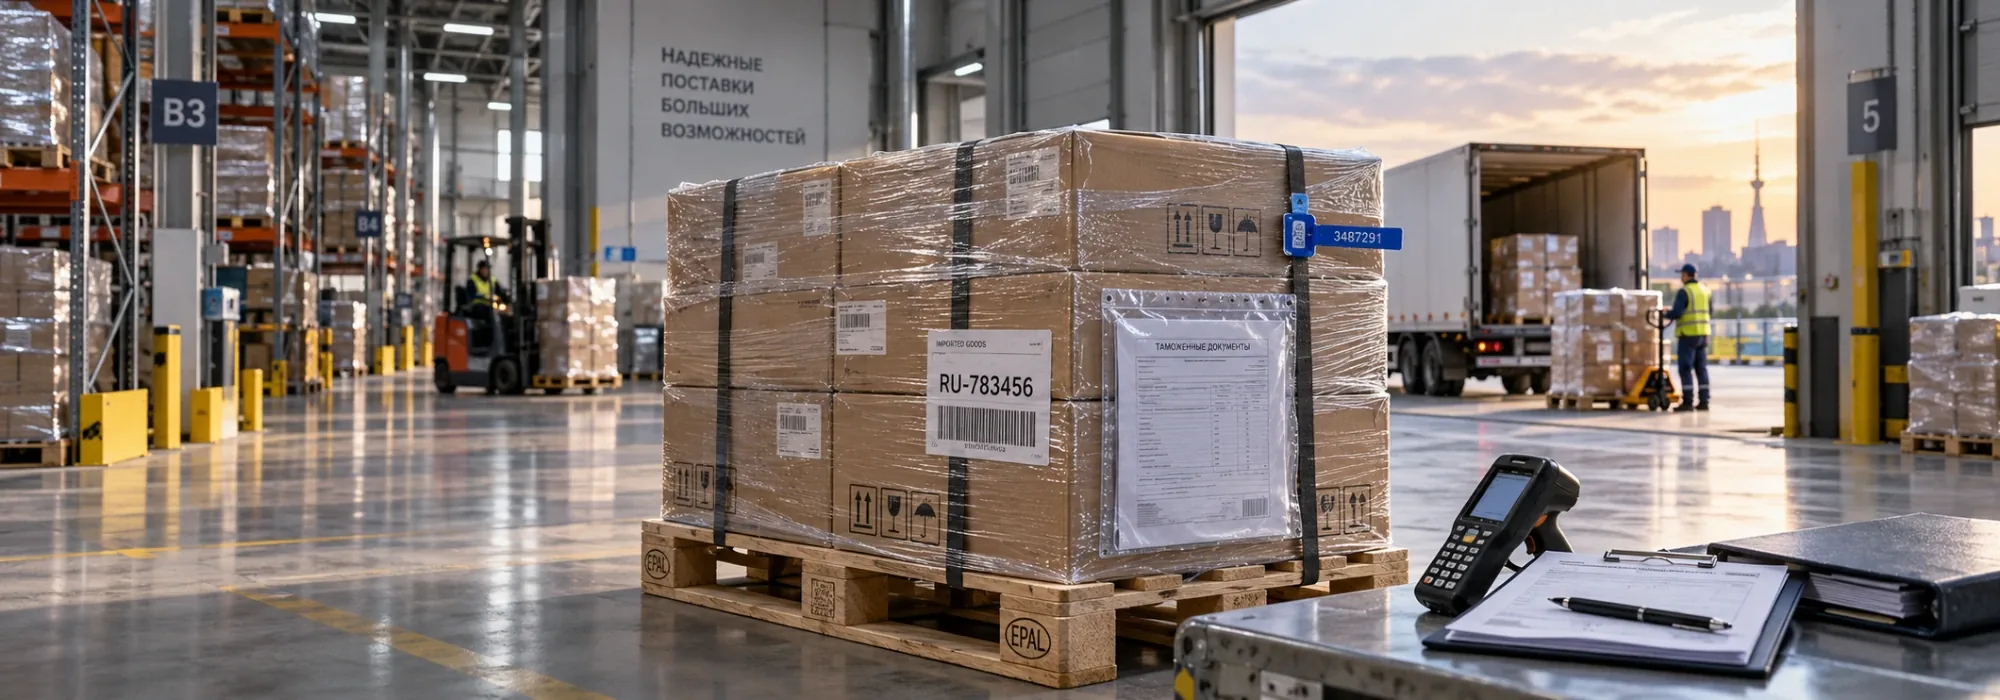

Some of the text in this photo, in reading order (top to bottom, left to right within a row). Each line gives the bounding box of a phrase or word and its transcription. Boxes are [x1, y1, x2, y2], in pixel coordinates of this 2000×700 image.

[661, 47, 763, 72] НАДЕЖНЫЕ
[661, 73, 754, 94] ПОСТАВКИ
[164, 97, 206, 128] B3
[661, 98, 749, 118] БОЛЬШИХ
[1862, 98, 1880, 133] 5
[661, 123, 806, 145] ВОЗМОЖНОСТЕЙ
[358, 216, 378, 232] B4
[1333, 230, 1382, 244] 3487291
[1155, 342, 1251, 352] ТАМОЖЕННЫЕ ДОКУМЕНТЫ
[939, 373, 1034, 398] RU-783456
[647, 553, 667, 574] EPAL
[1011, 624, 1046, 652] EPAL
